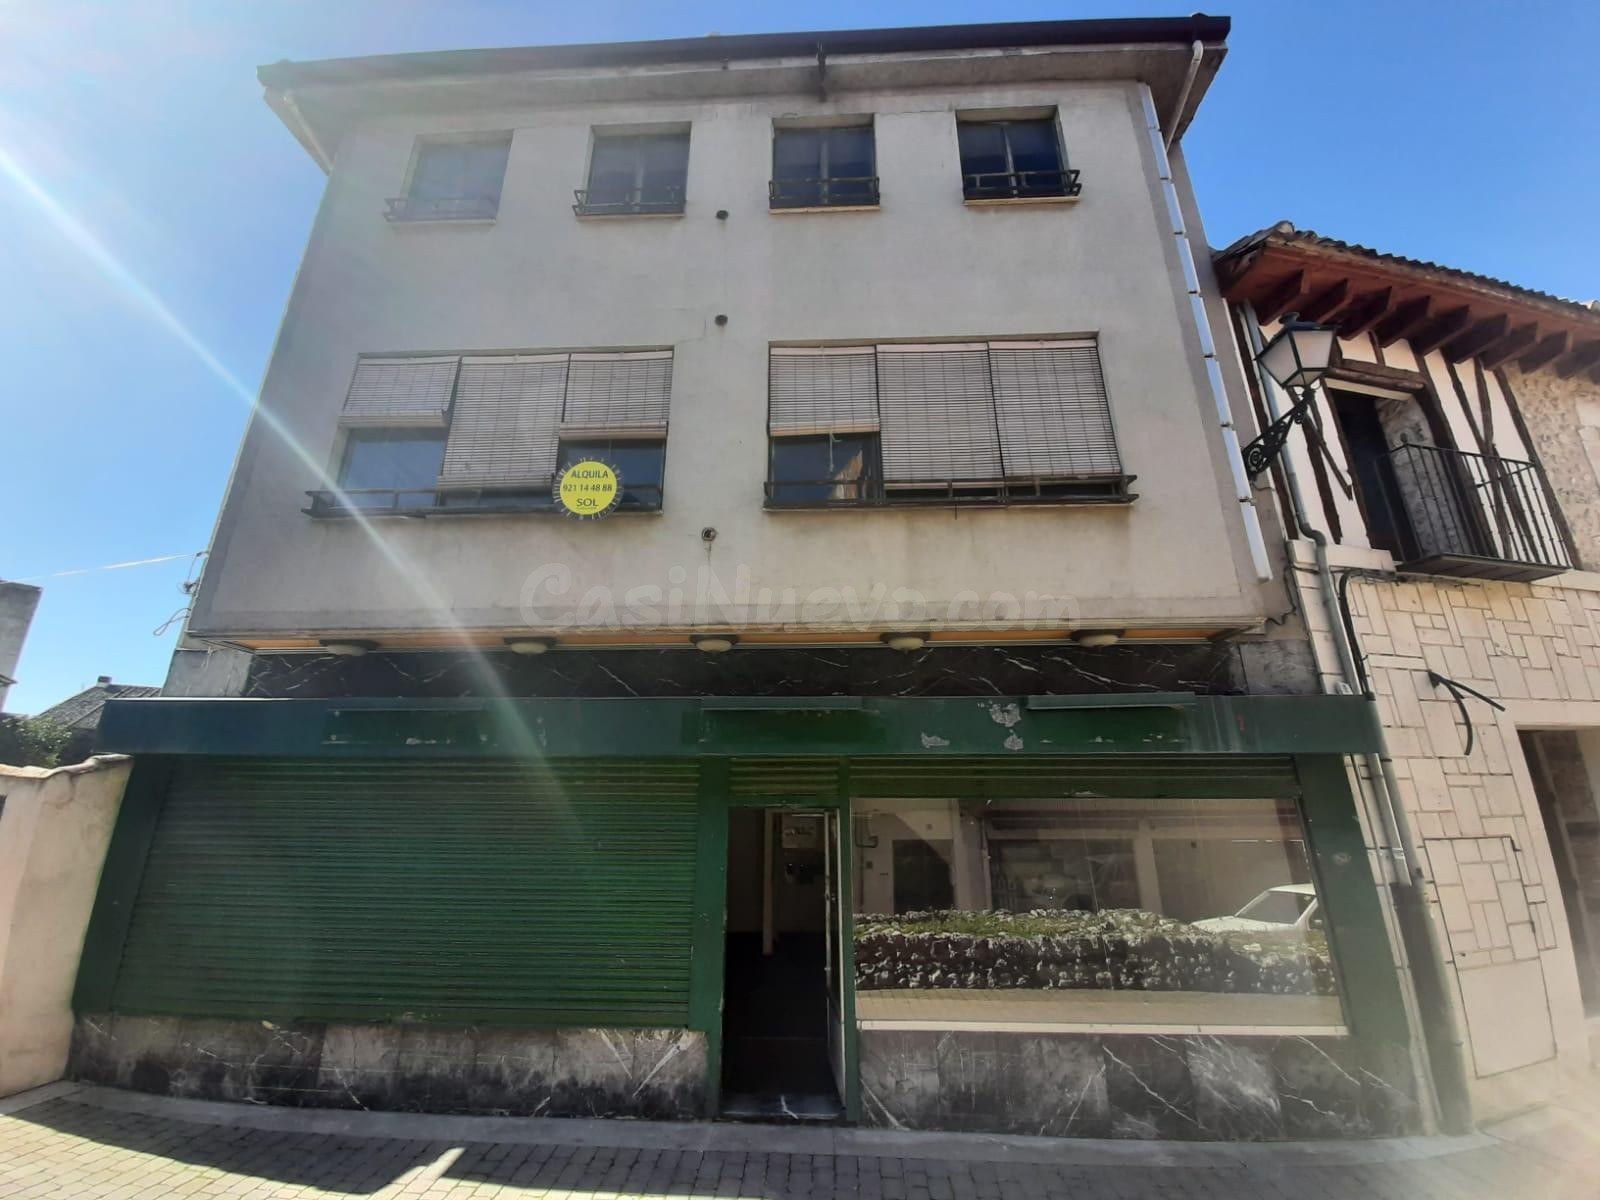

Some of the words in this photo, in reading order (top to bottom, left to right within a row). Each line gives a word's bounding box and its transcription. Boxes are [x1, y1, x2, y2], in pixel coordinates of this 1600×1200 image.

[571, 470, 608, 478] ALQUILA
[563, 484, 577, 492] 921
[580, 484, 589, 492] 14
[590, 484, 601, 492] 48
[602, 484, 612, 492] 88
[576, 498, 598, 507] SOL
